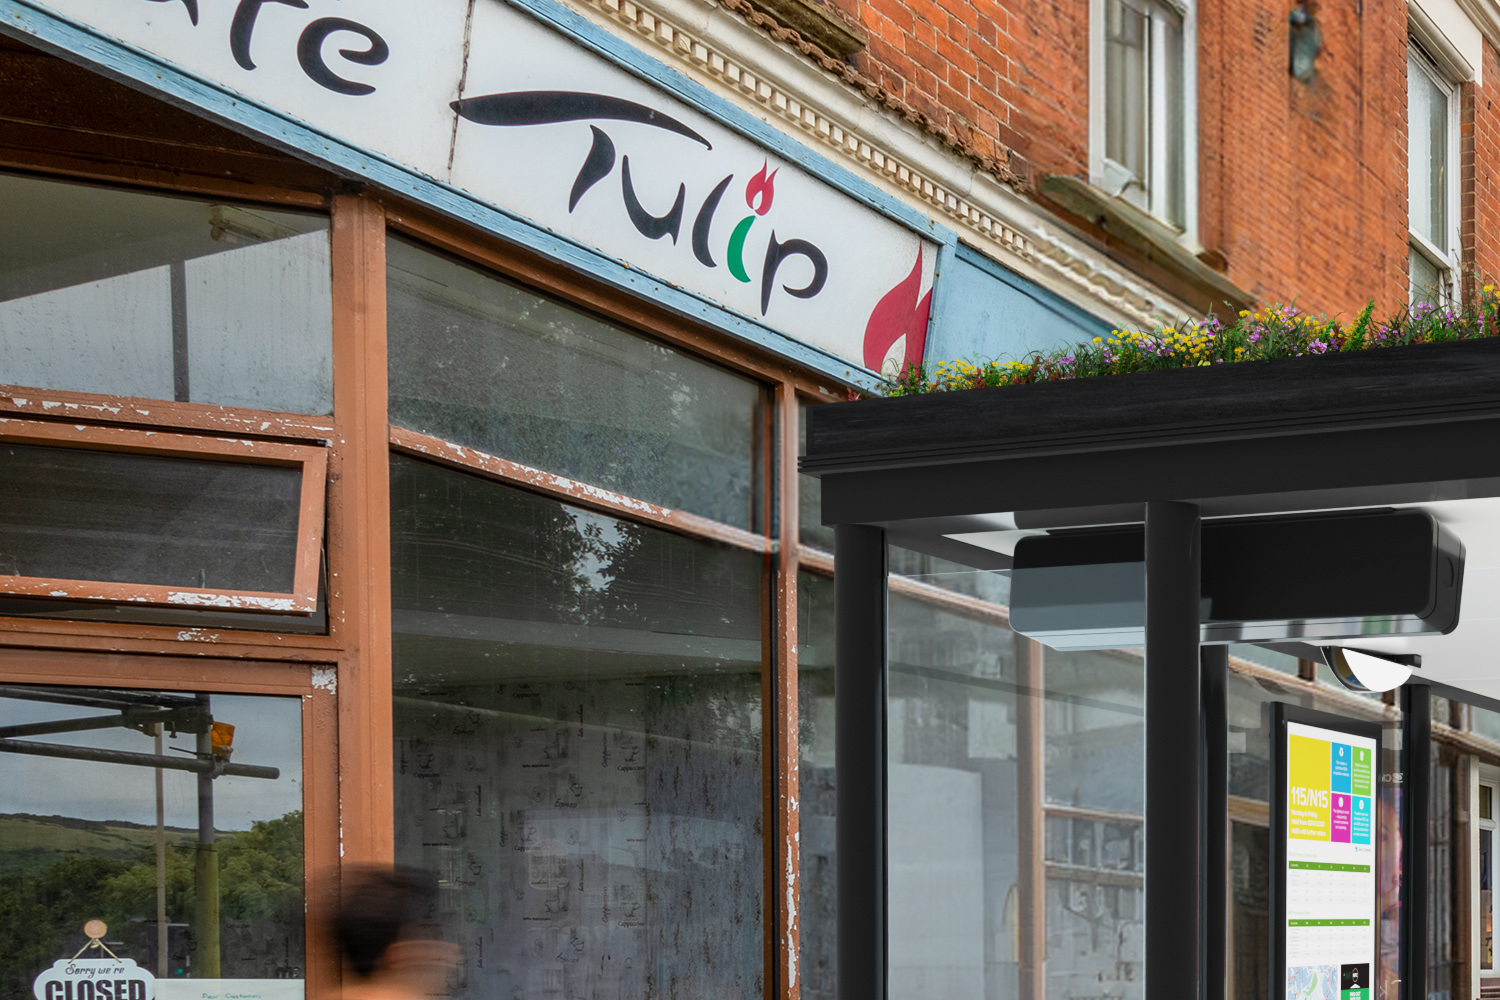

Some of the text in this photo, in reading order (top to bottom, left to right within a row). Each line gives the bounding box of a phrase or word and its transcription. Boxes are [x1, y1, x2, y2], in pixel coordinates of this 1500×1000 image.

[450, 90, 828, 316] Tulip
[1291, 786, 1328, 808] 115/N15
[65, 964, 124, 978] Sorry we're
